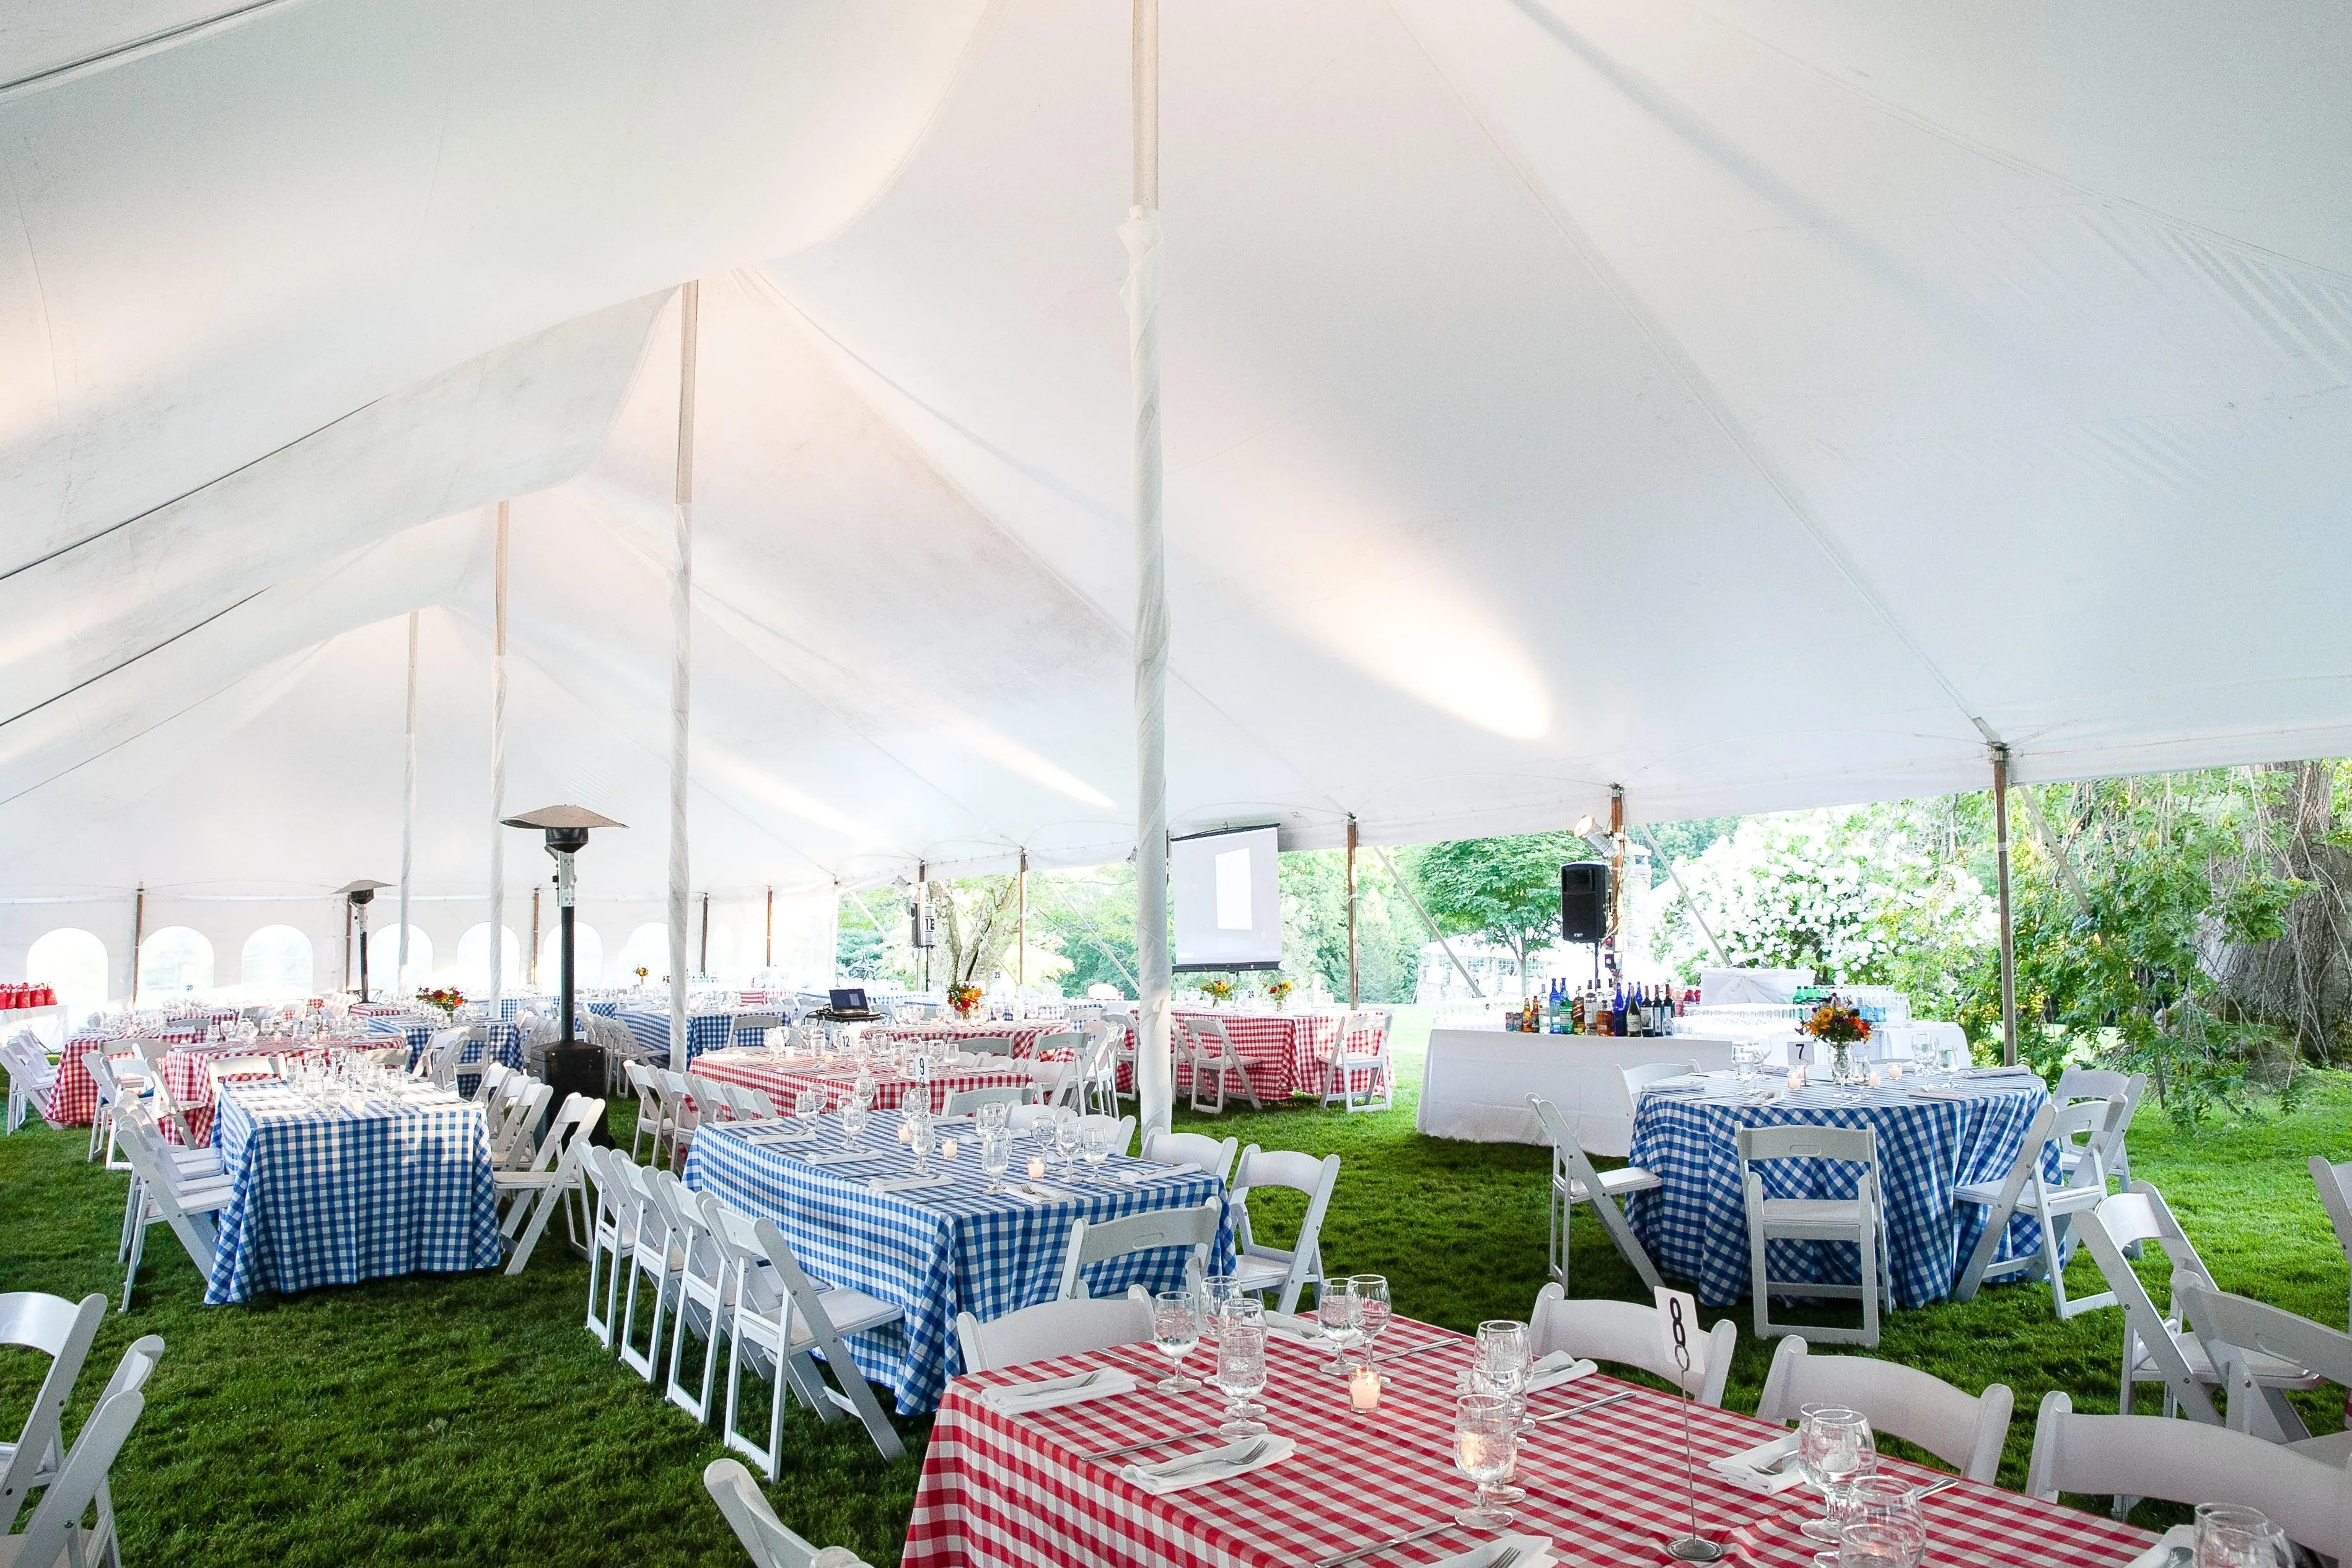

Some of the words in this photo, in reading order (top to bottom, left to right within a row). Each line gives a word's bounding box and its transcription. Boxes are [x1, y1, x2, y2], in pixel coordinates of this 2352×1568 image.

[842, 1036, 849, 1047] 12
[1796, 1043, 1804, 1059] 7
[919, 1058, 924, 1075] 9
[1669, 1297, 1686, 1347] 8
